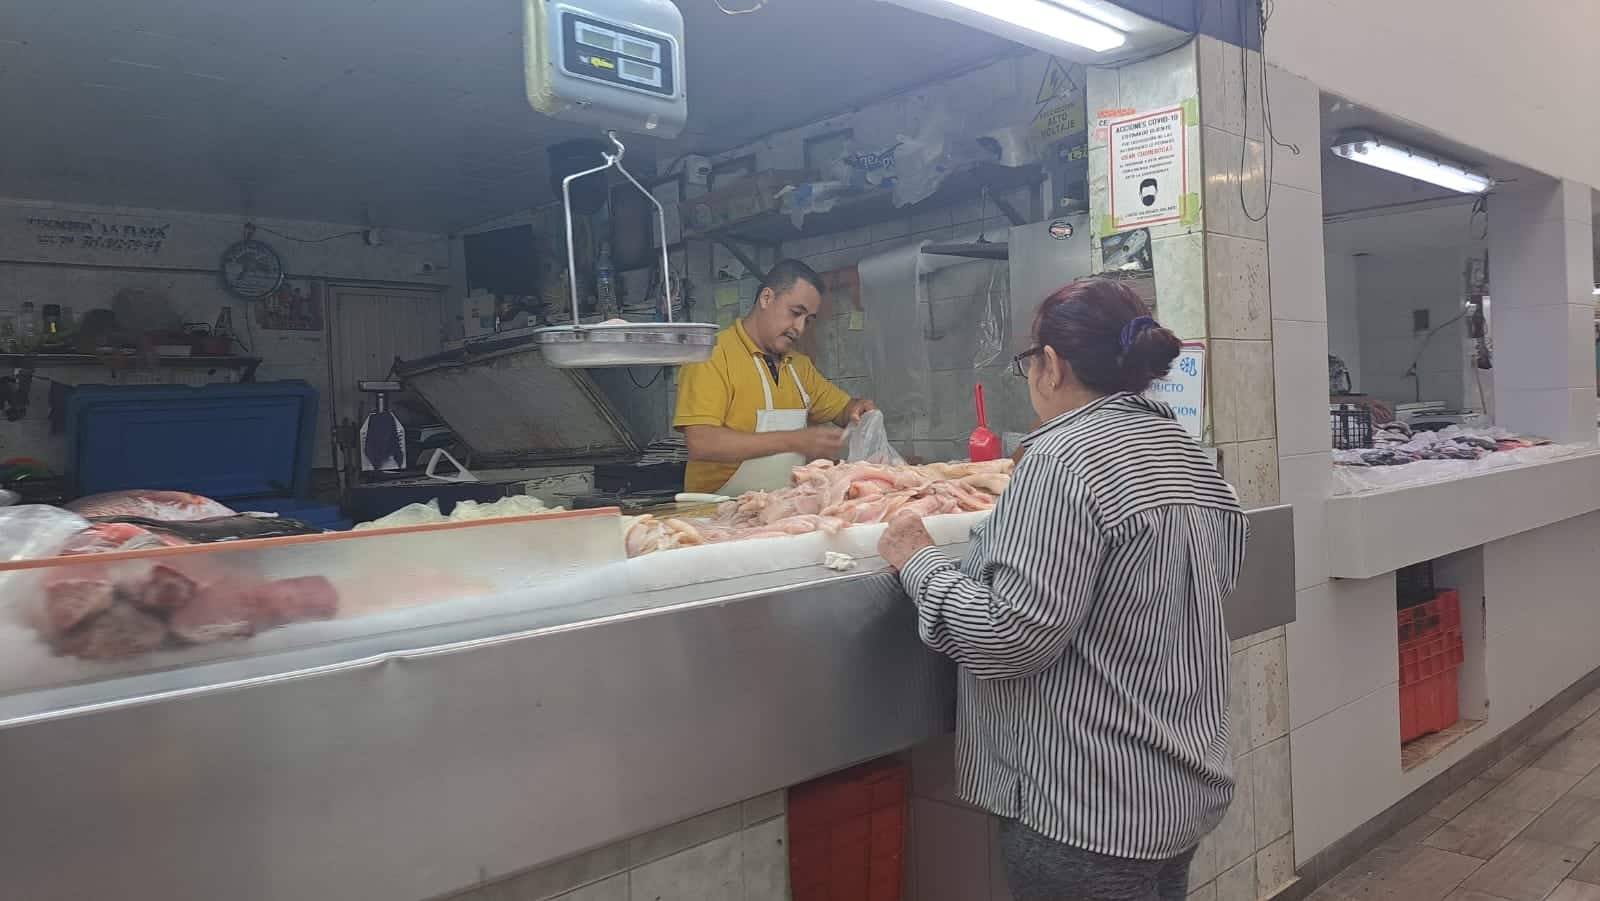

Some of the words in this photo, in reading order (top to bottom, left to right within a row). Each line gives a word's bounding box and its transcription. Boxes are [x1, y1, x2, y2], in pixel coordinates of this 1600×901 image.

[1116, 120, 1147, 133] ACCIONES
[1147, 113, 1179, 127] COVID-19
[1151, 383, 1183, 392] DUCTO
[1172, 407, 1196, 416] CION
